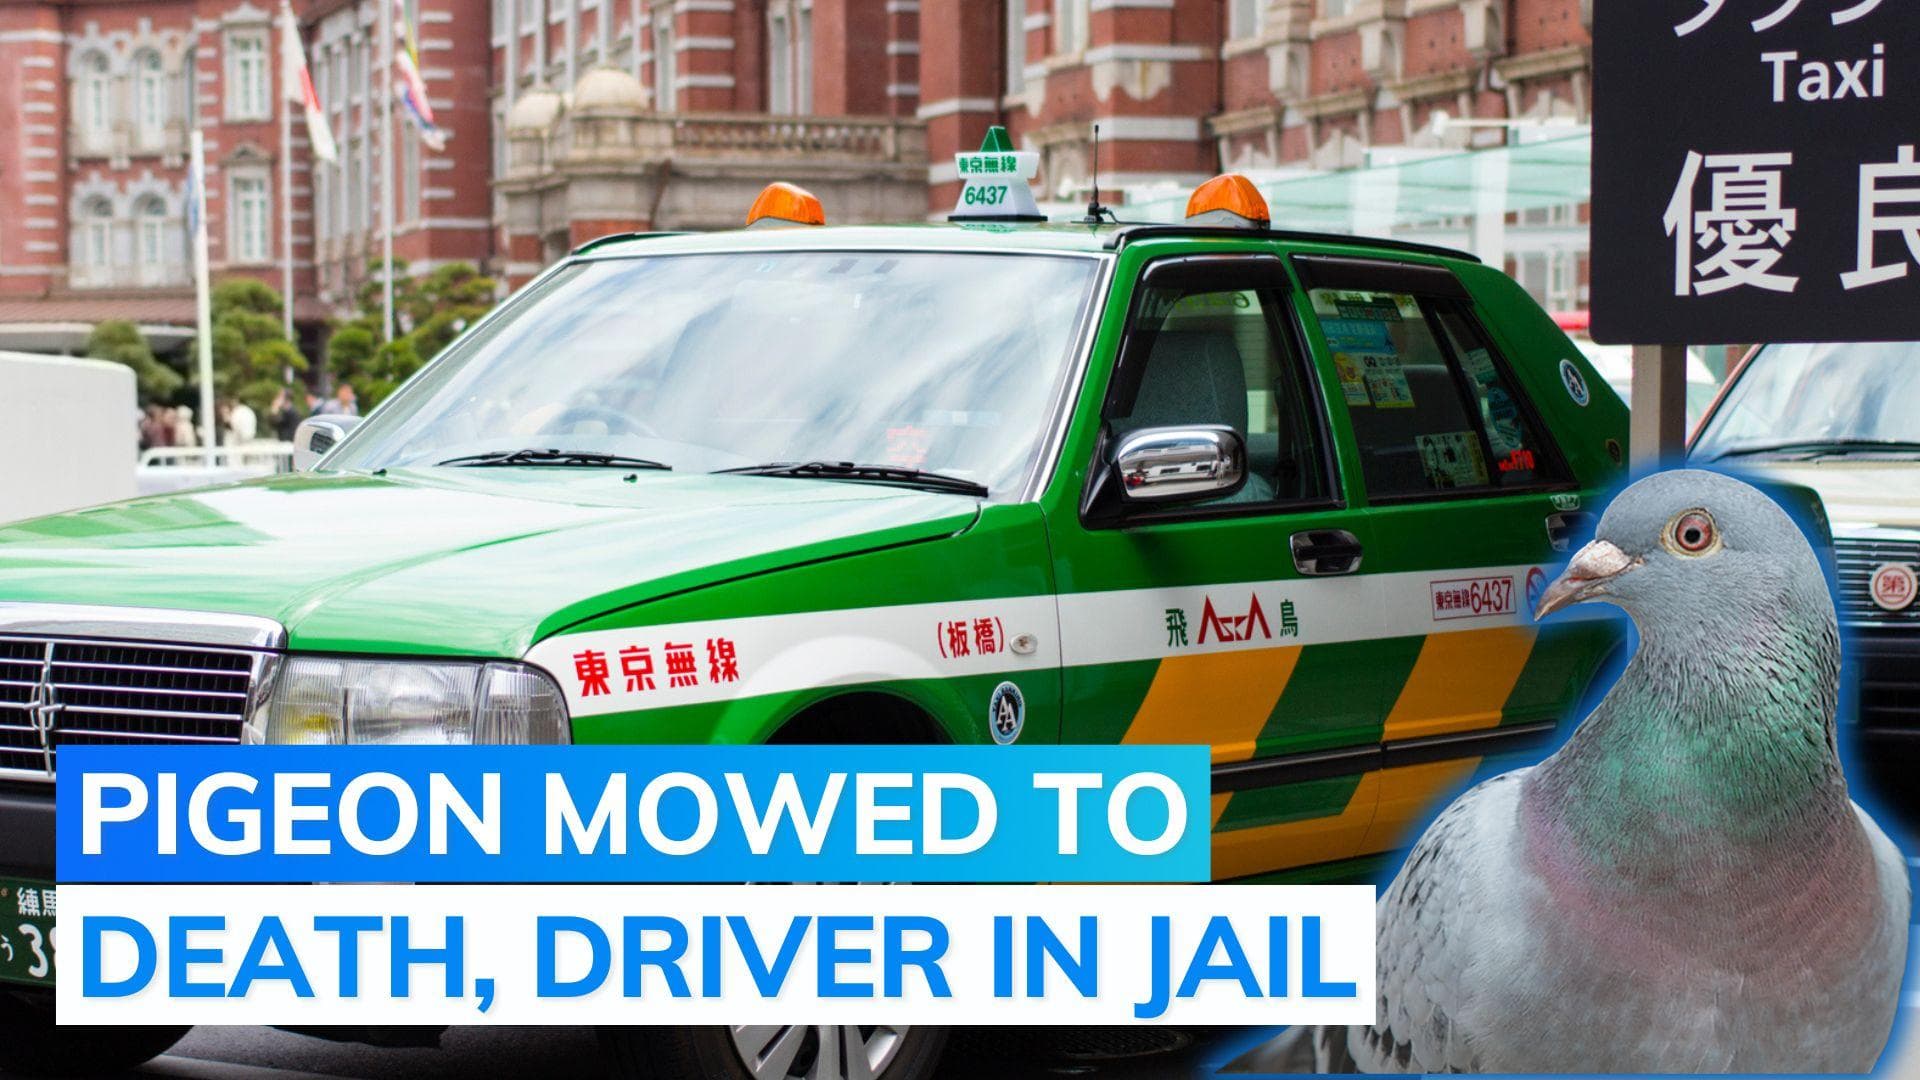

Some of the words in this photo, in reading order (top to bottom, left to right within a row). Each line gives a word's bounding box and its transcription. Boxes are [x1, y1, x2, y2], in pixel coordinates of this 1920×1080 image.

[1761, 43, 1884, 102] Taxi
[958, 155, 1017, 173] 東京無線
[964, 185, 1008, 205] 6437
[1663, 145, 1920, 296] 優良
[573, 637, 739, 697] 東京無線
[16, 886, 56, 917] 練馬
